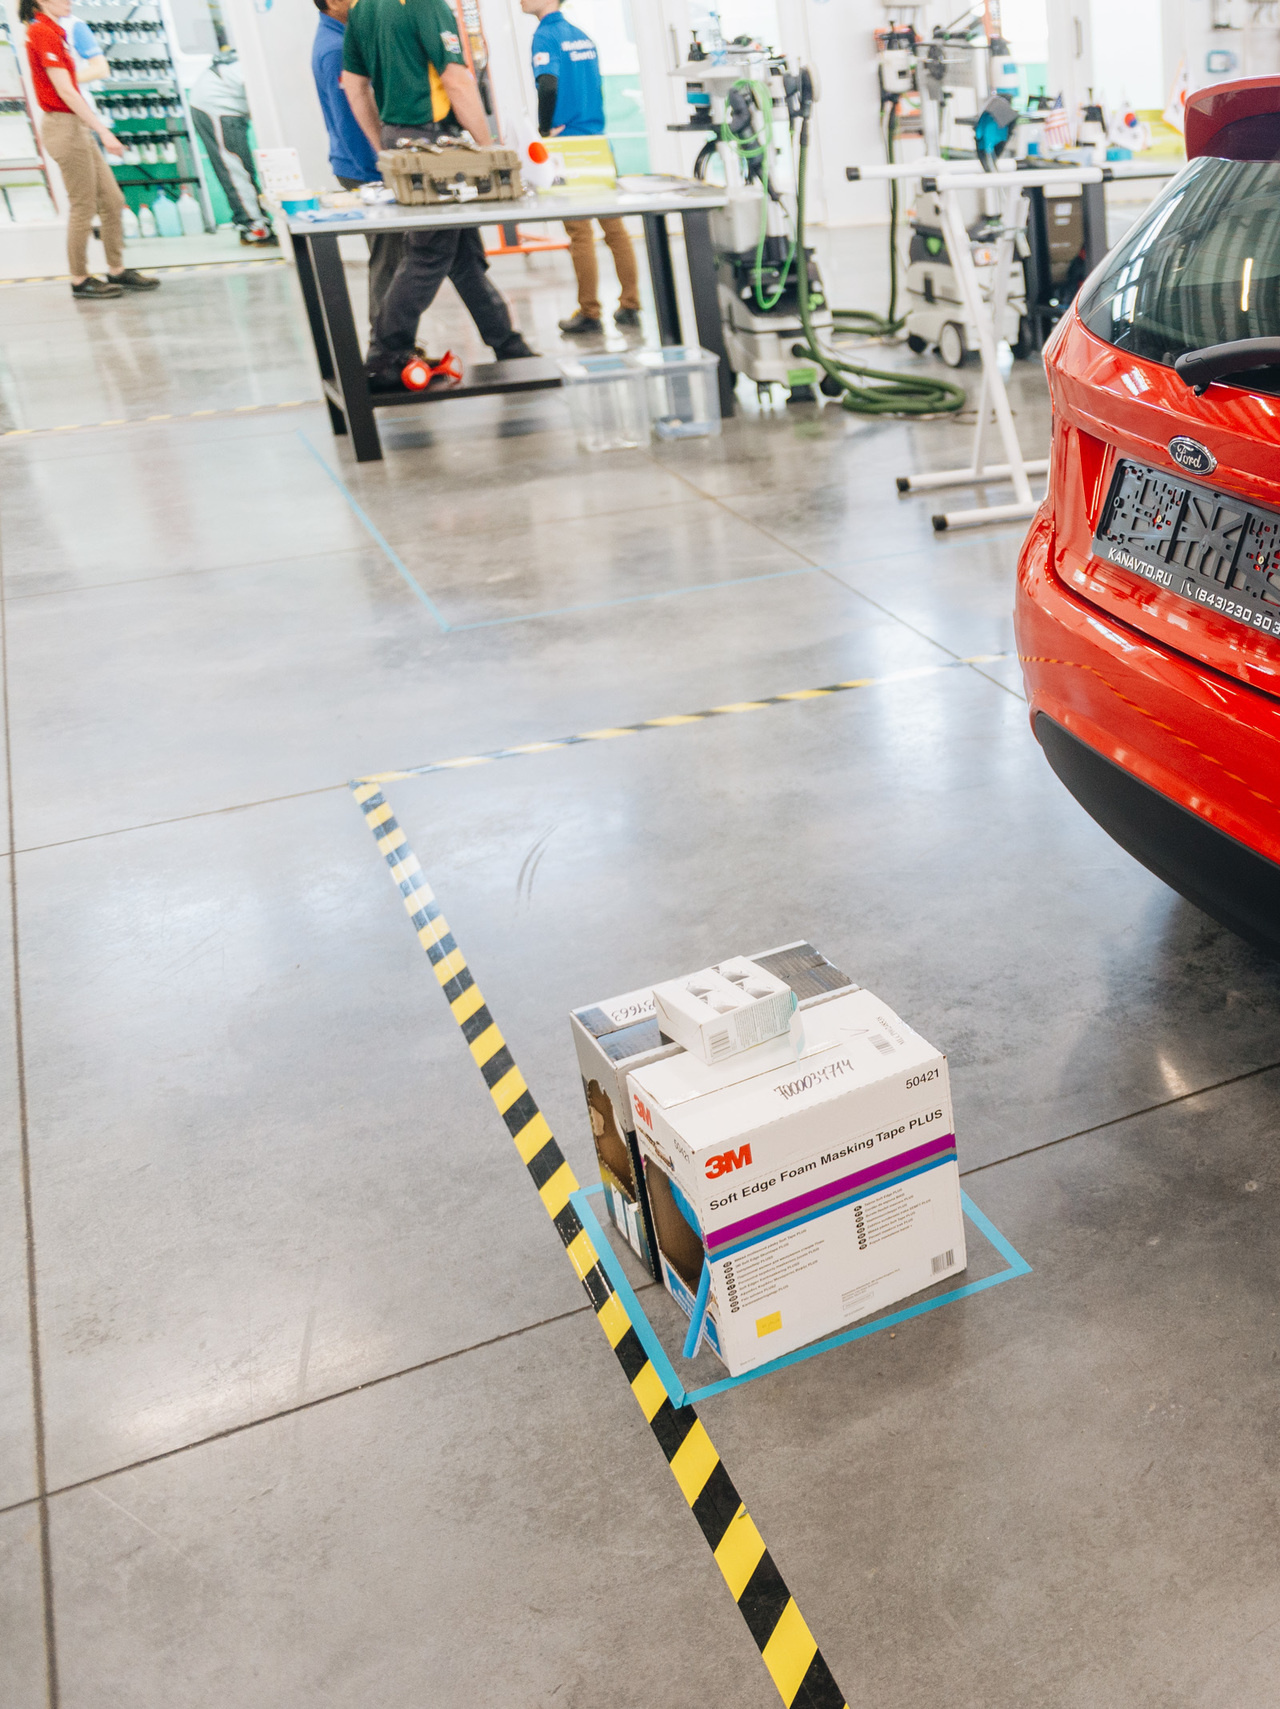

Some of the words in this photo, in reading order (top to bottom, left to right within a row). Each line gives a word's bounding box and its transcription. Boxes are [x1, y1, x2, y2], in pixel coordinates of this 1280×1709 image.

[1175, 443, 1202, 469] Ford
[1107, 547, 1173, 586] KANAVTO.RU
[1194, 587, 1252, 622] (843)230
[1253, 613, 1272, 631] 30
[905, 1068, 940, 1090] 50421
[633, 1094, 654, 1131] 3M
[704, 1143, 753, 1180] 3M
[709, 1192, 738, 1211] Soft
[742, 1177, 777, 1198] Edge
[780, 1160, 817, 1182] Foam
[820, 1137, 874, 1166] Masking
[876, 1125, 906, 1144] Tape
[909, 1109, 943, 1130] PLUS
